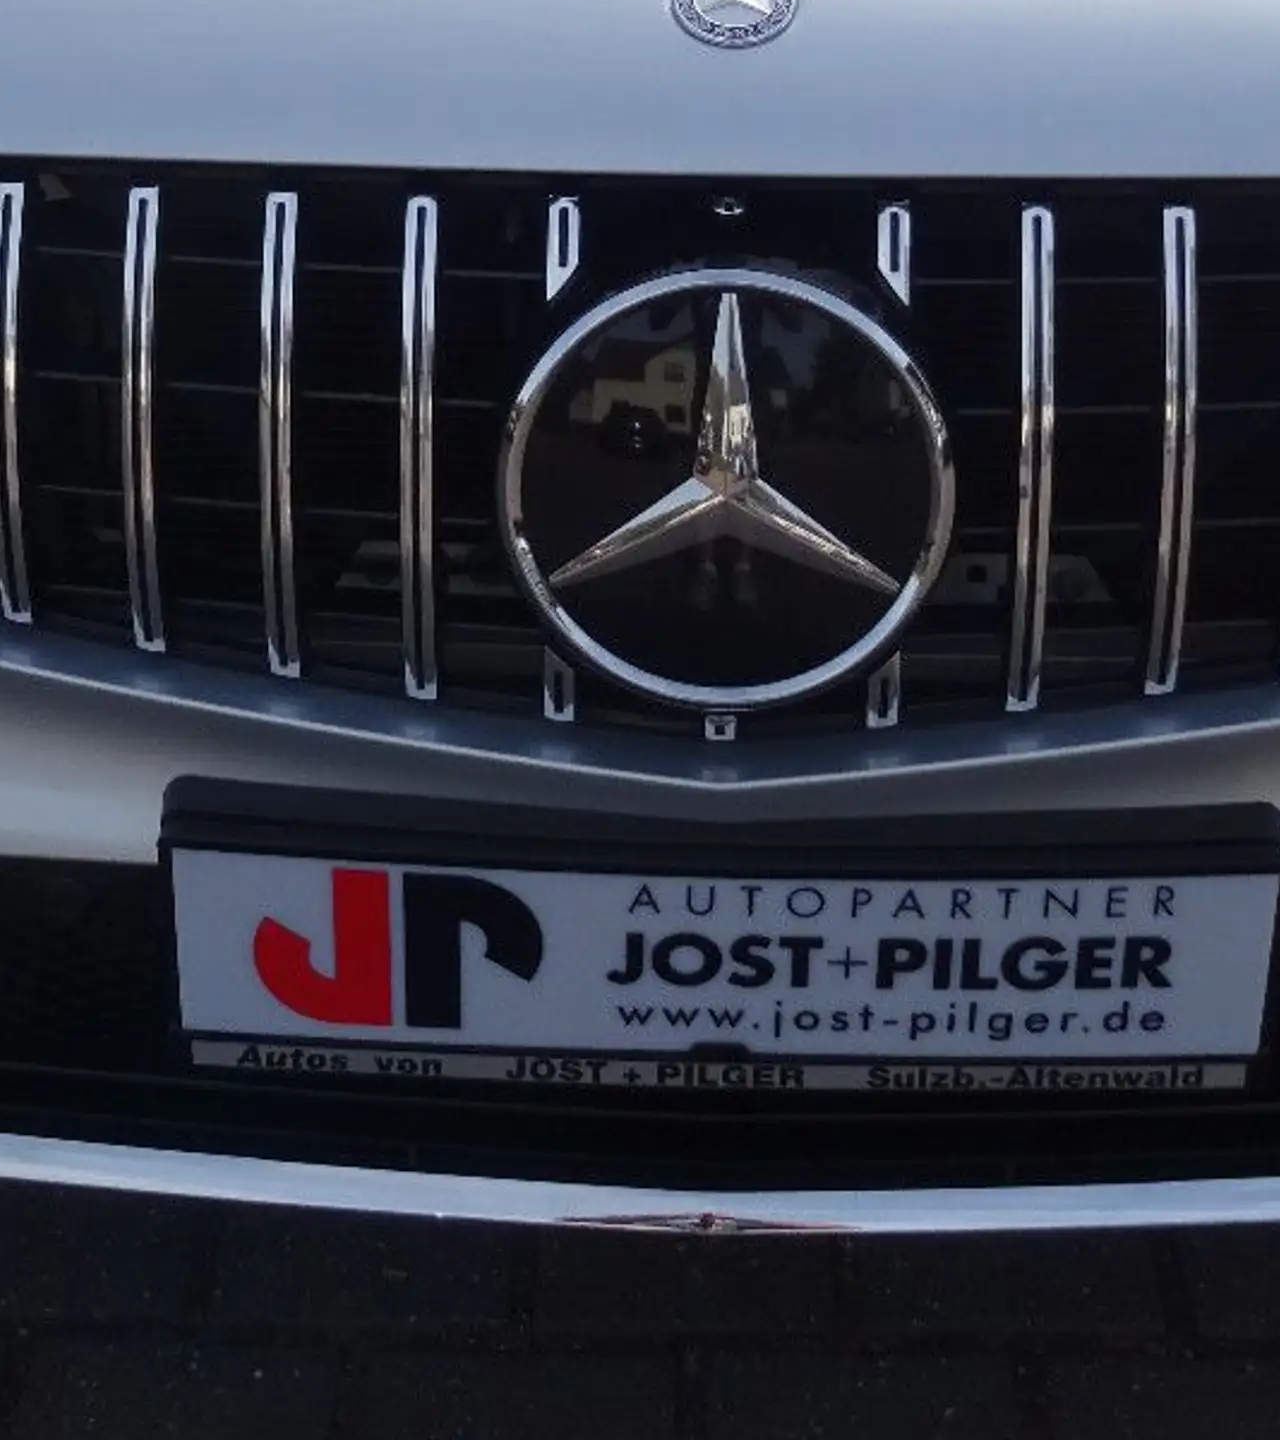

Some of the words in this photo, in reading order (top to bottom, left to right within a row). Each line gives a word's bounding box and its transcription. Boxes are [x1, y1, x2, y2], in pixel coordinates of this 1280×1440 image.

[627, 884, 1176, 920] AUTOPARTNER
[606, 932, 1173, 991] JOST+PILGER
[617, 1000, 1166, 1041] www.jost-pilger.de
[237, 1044, 350, 1074] Autos
[375, 1054, 444, 1076] von
[506, 1057, 608, 1083] JOST
[656, 1061, 805, 1089] PILGER
[866, 1063, 1205, 1090] Sulzb.-Altenwald
